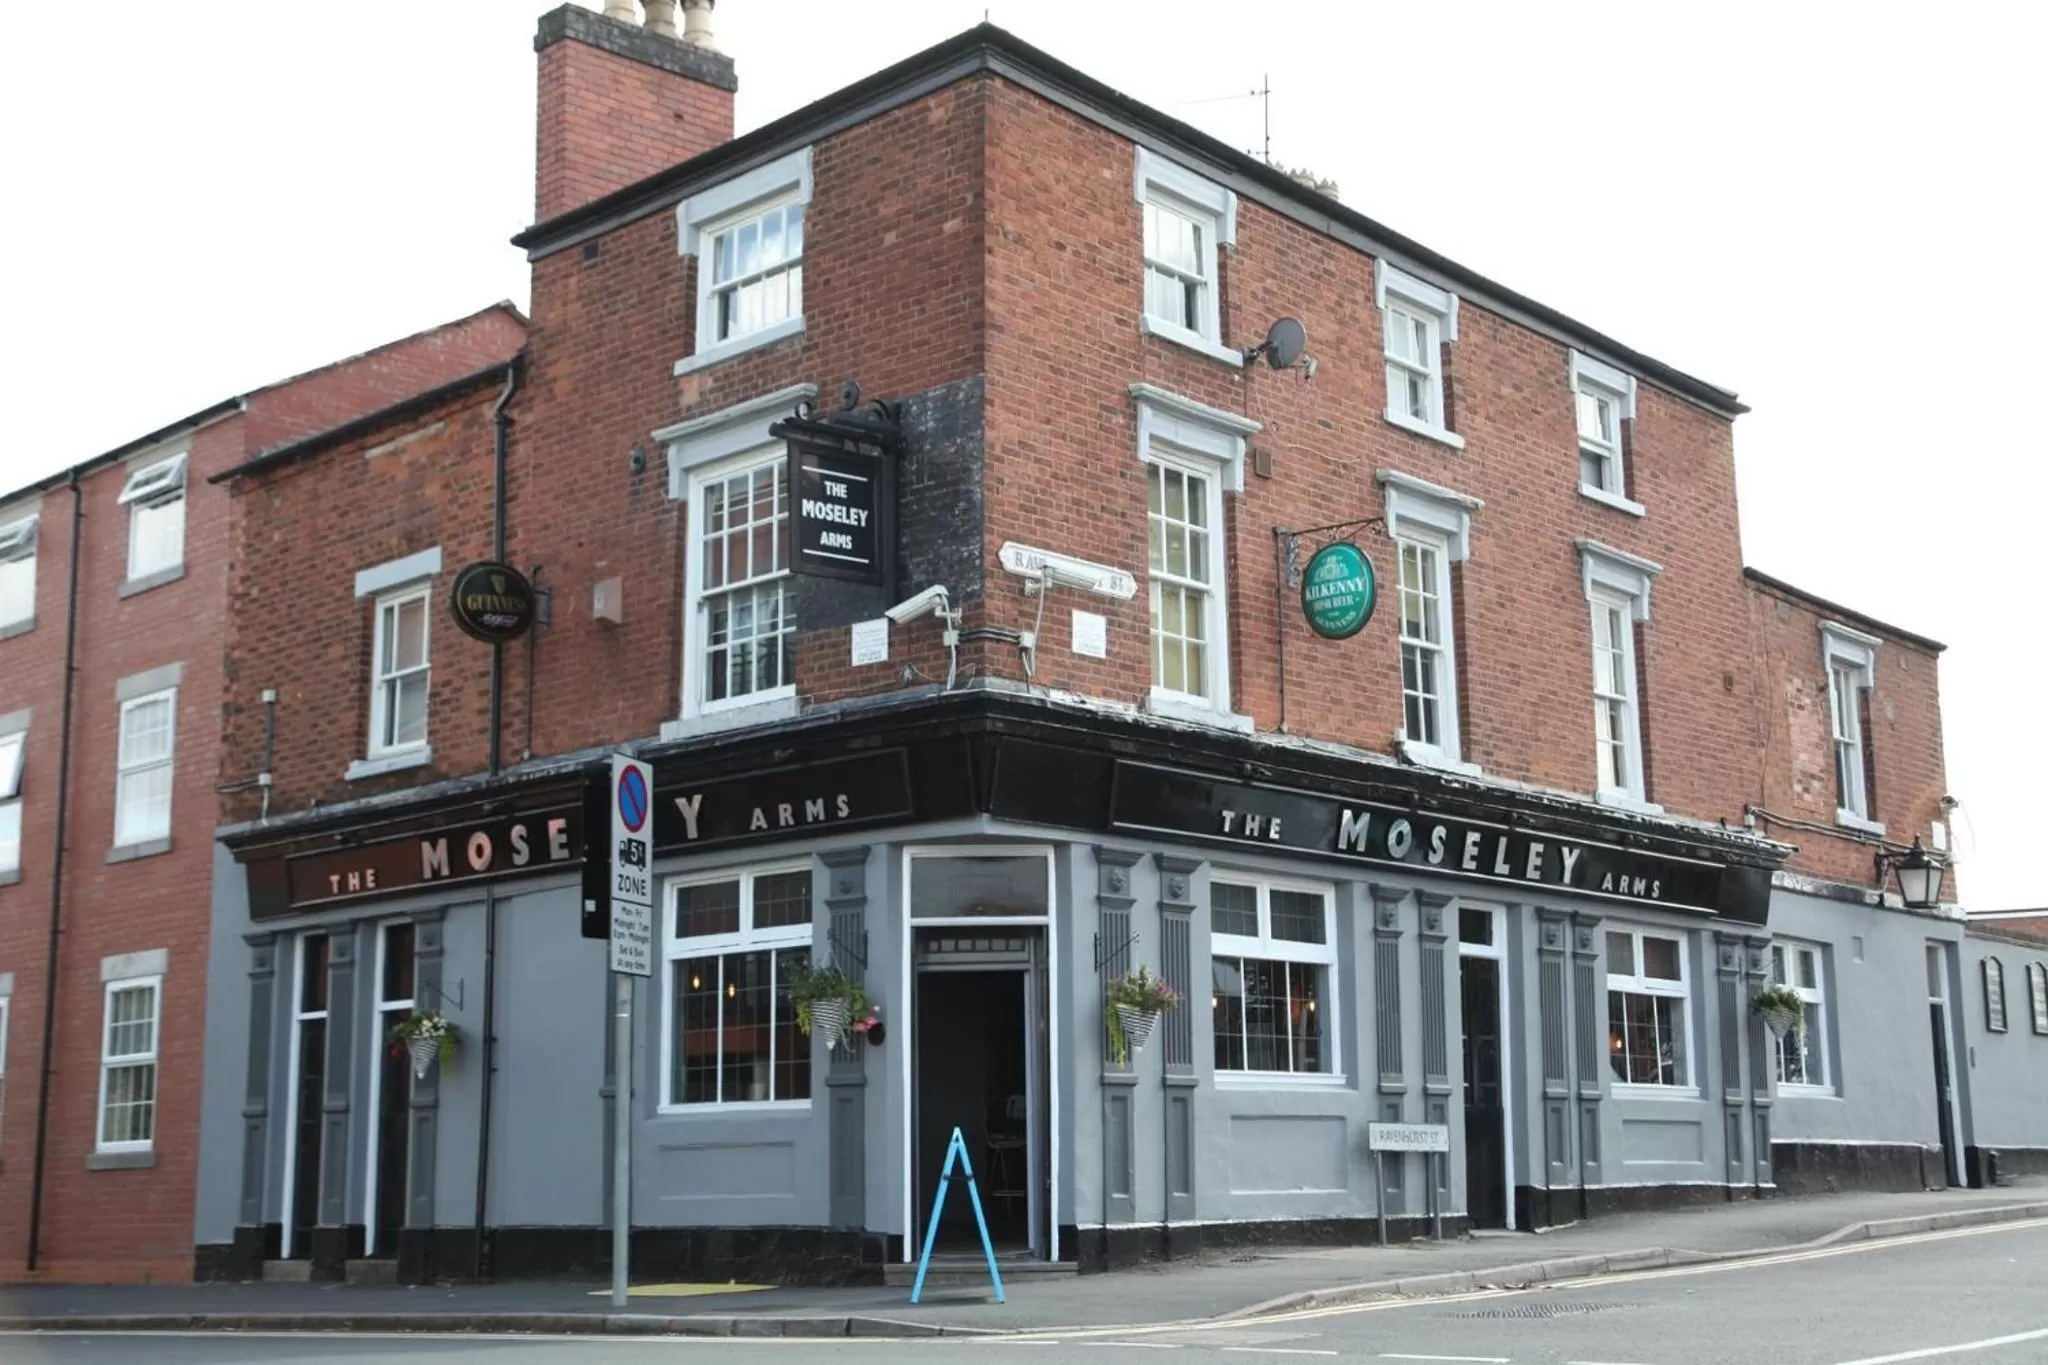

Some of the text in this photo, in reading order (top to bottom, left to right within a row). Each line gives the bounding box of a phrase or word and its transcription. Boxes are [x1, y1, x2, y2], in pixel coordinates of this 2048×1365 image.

[824, 480, 848, 498] THE
[802, 498, 868, 527] MOSELEY
[820, 531, 852, 550] ARMS
[1306, 577, 1363, 601] KILKENNY
[329, 793, 849, 894] THE MOSEY ARMS
[1221, 809, 1660, 898] THE MOSELEY ARMS
[618, 874, 646, 896] ZONE
